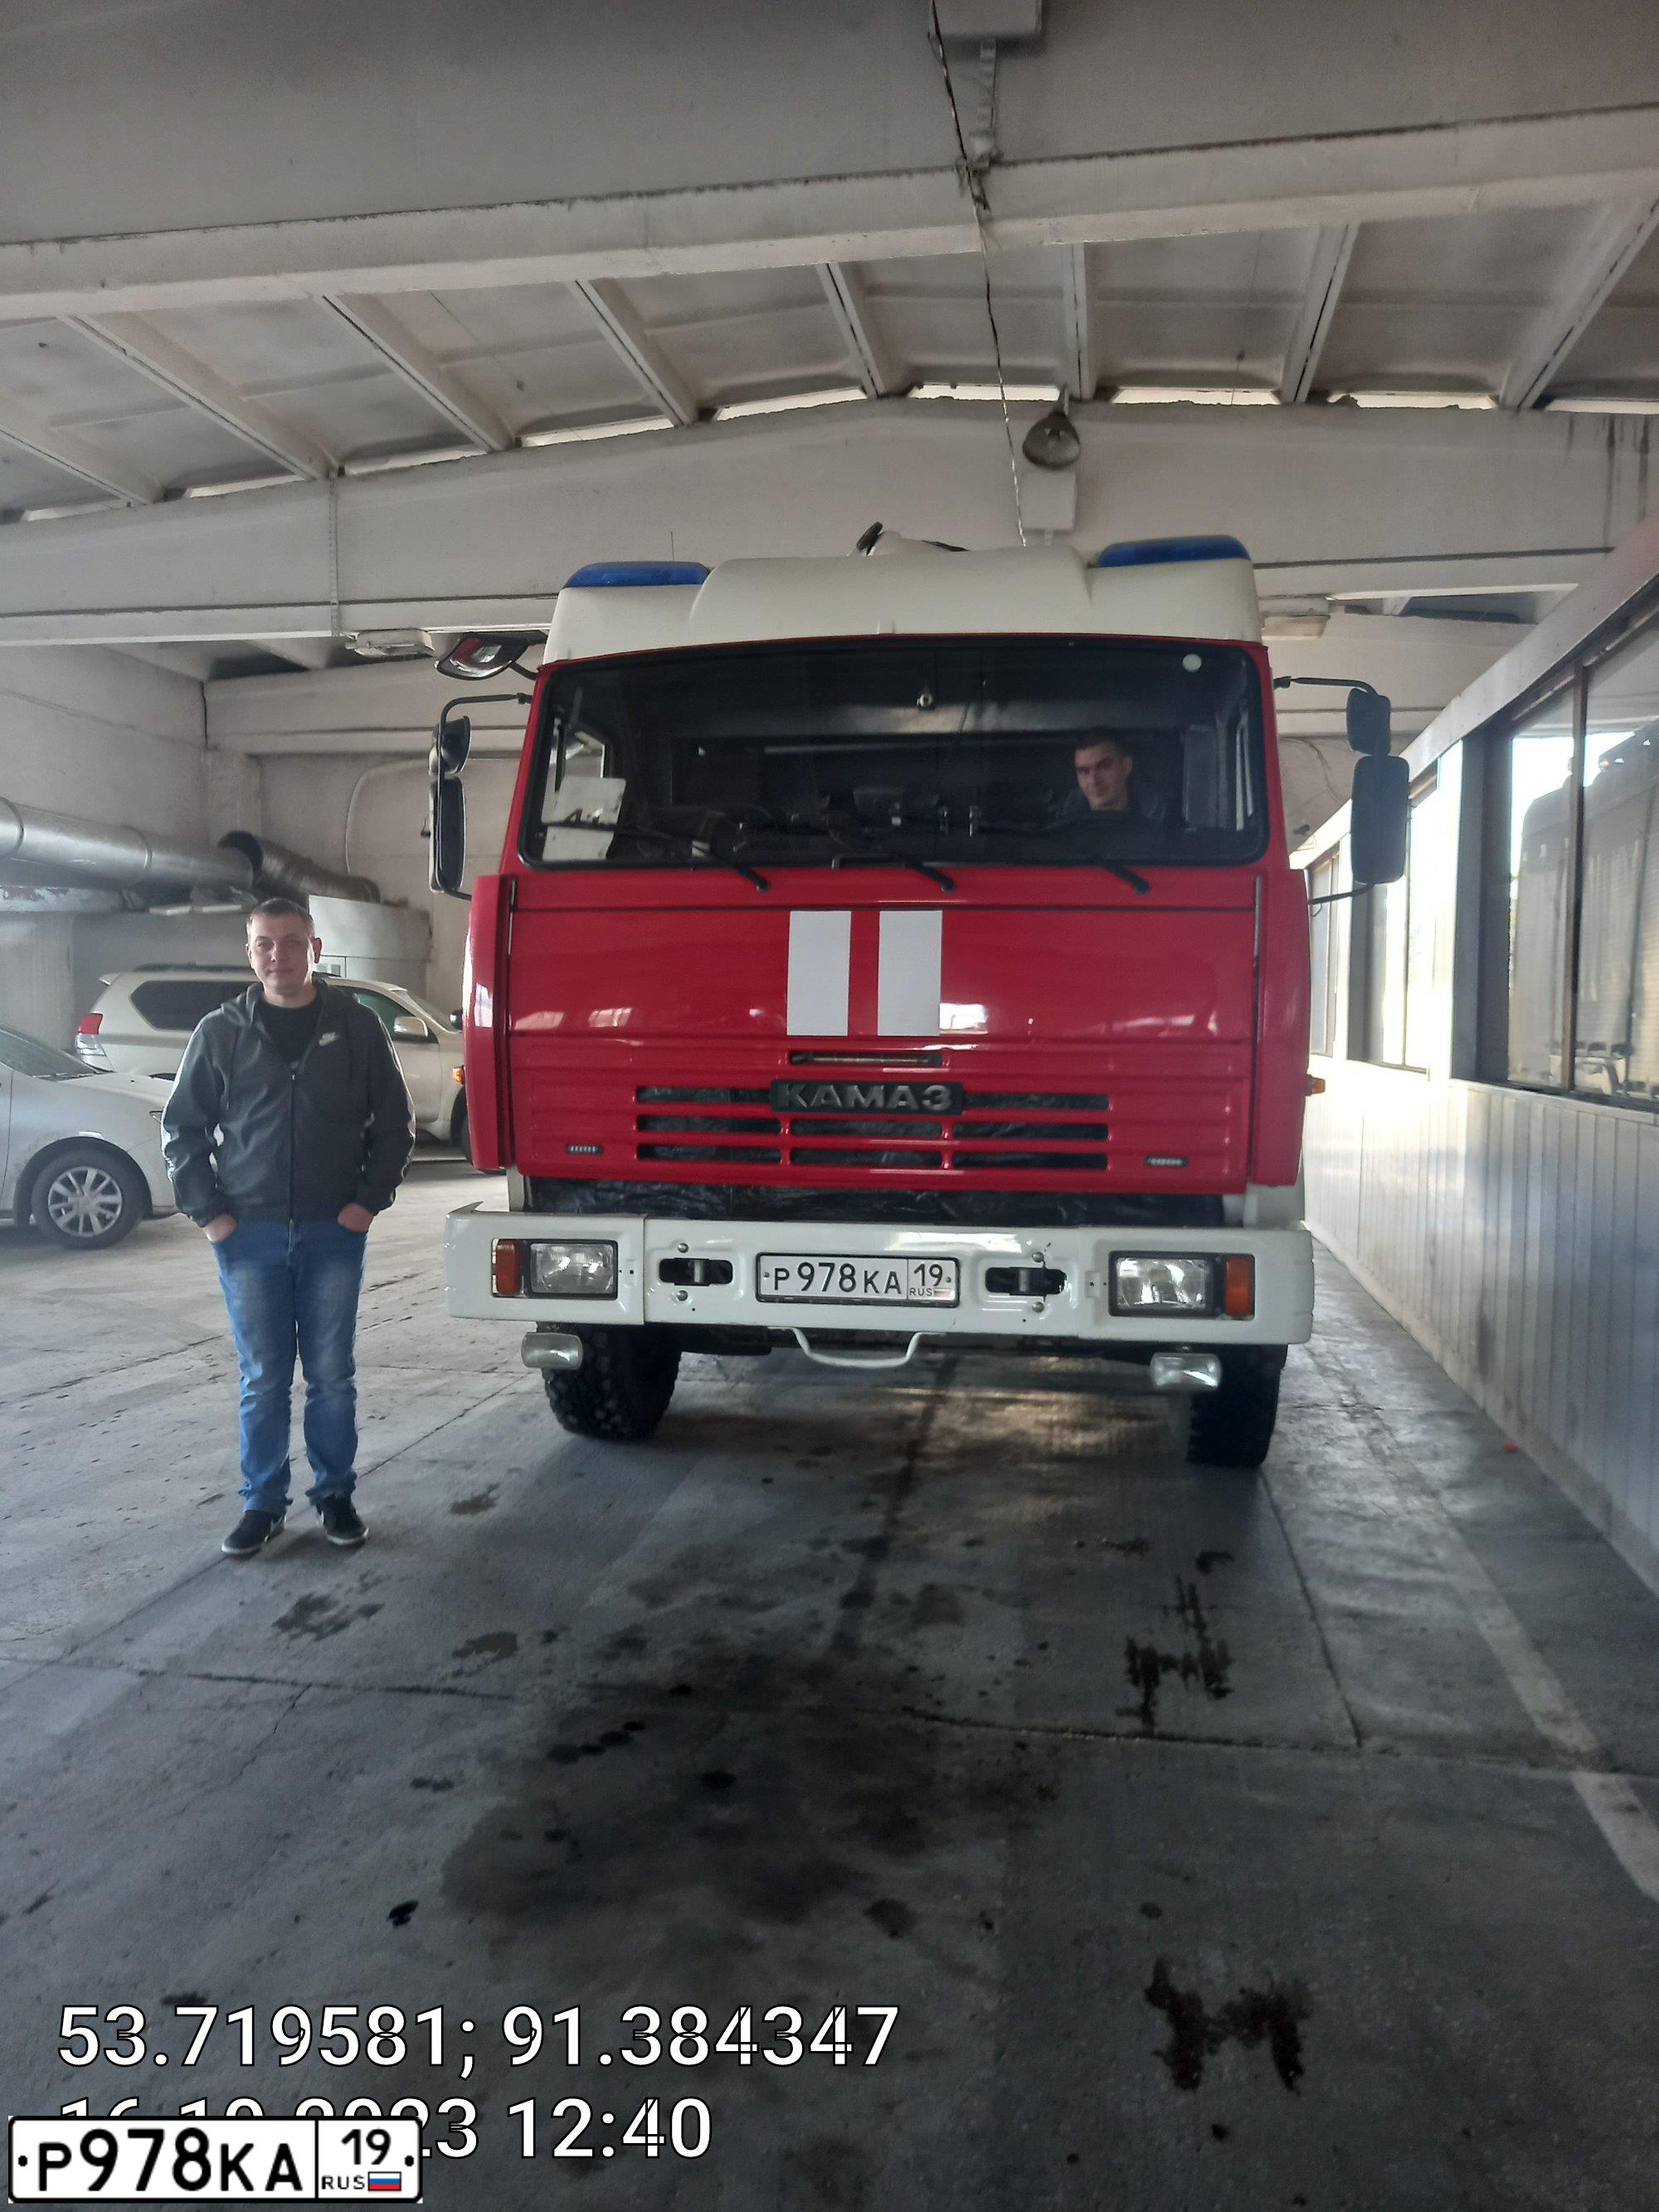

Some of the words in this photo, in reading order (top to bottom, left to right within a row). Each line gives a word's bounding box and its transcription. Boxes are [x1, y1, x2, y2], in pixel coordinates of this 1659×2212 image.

[778, 1084, 953, 1111] КАМАЗ
[773, 1261, 902, 1295] Р978КА
[912, 1264, 944, 1287] 19
[909, 1287, 933, 1297] RUS
